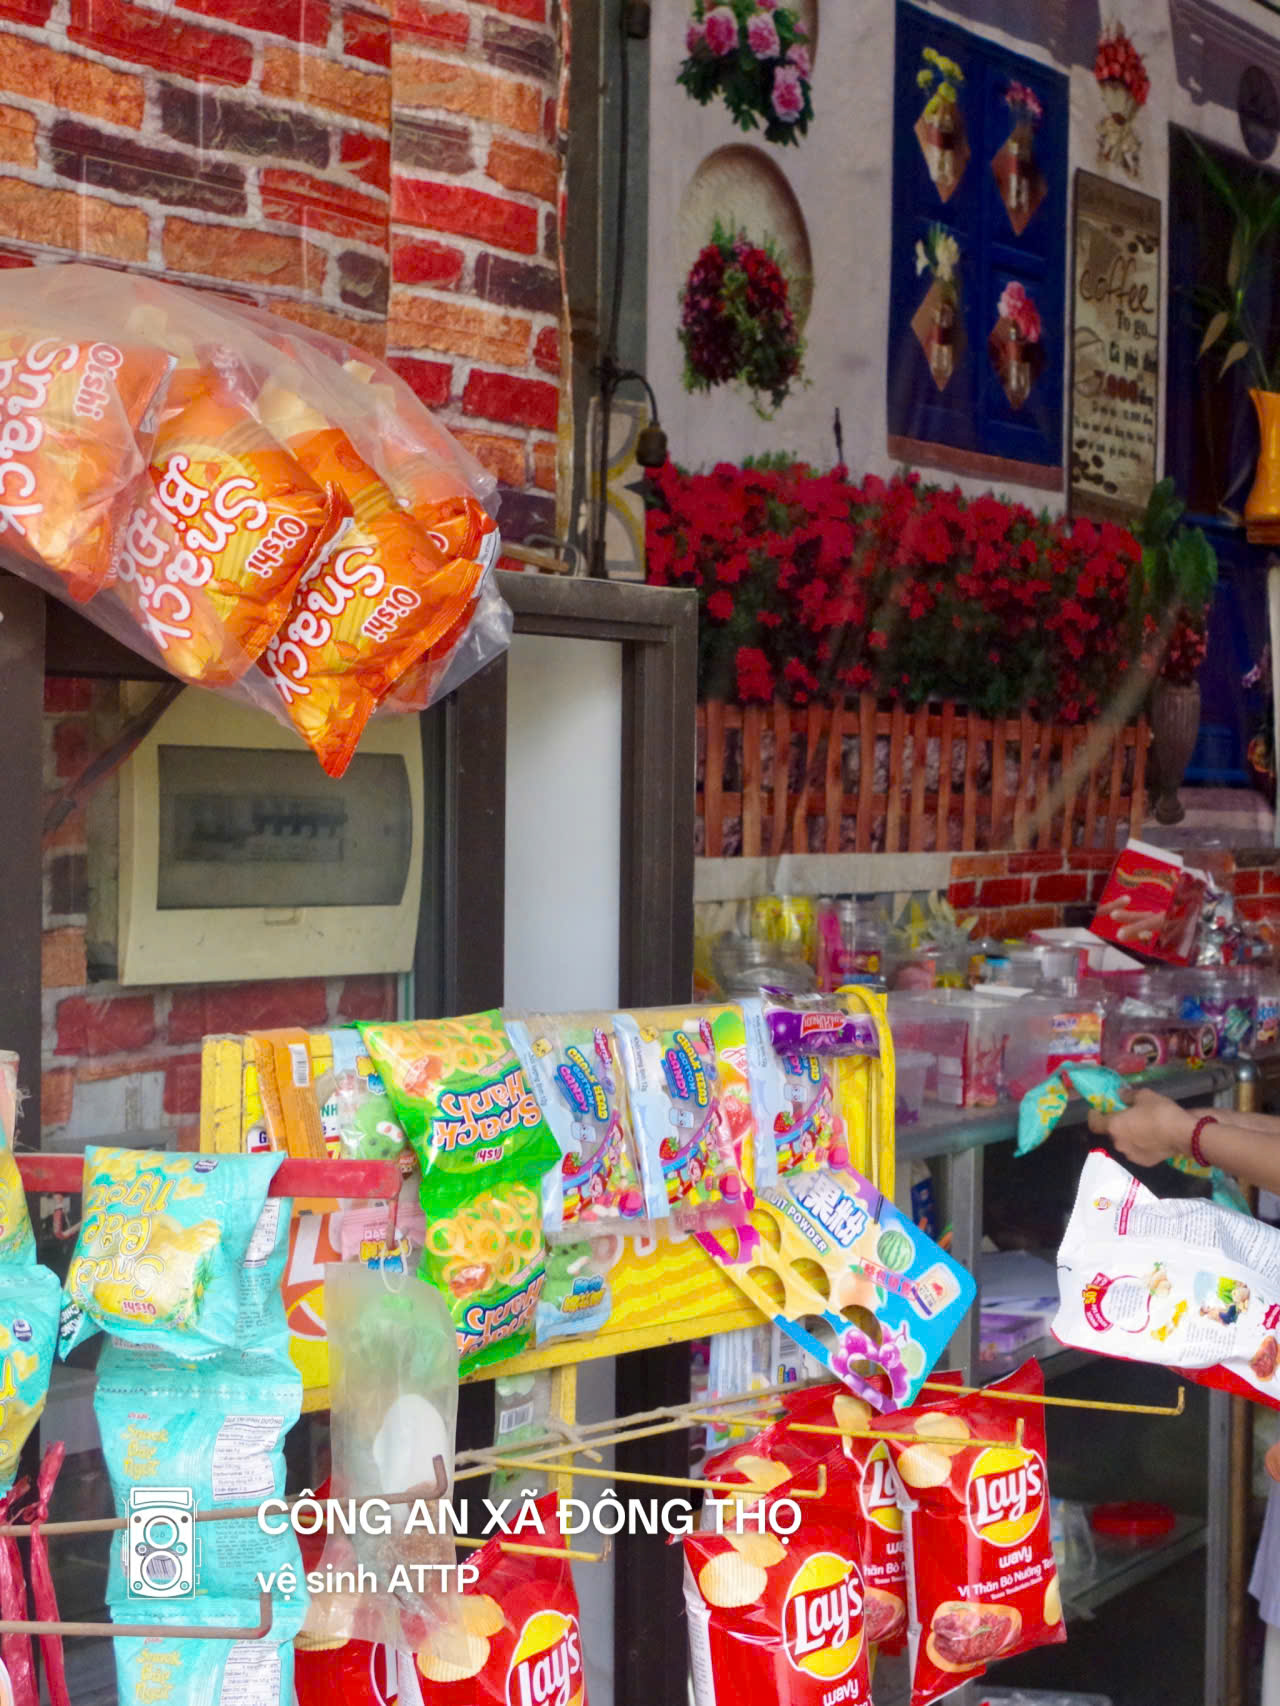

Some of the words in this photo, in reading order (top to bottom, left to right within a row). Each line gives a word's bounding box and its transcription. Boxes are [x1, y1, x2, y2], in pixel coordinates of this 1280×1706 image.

[1080, 256, 1154, 314] coffee
[73, 342, 123, 420] Oishi
[141, 476, 268, 650] Snack
[245, 515, 307, 578] Oishi
[267, 545, 385, 704] Snack
[361, 585, 421, 643] Oishi
[667, 1049, 689, 1098] CANDY
[675, 1032, 702, 1070] CHALK
[678, 1051, 697, 1091] COTTON
[559, 1066, 589, 1112] CANDY
[572, 1065, 595, 1105] COTTON
[432, 1093, 542, 1150] Snack
[786, 1203, 829, 1254] POWDER
[122, 1300, 158, 1316] Oishi
[975, 1457, 1043, 1526] Lay's
[864, 1564, 884, 1577] hăn
[999, 1545, 1033, 1569] wavy
[1000, 1571, 1014, 1588] Bò
[793, 1572, 864, 1657] Lay's
[517, 1627, 582, 1706] Lay's
[823, 1678, 861, 1706] wavy
